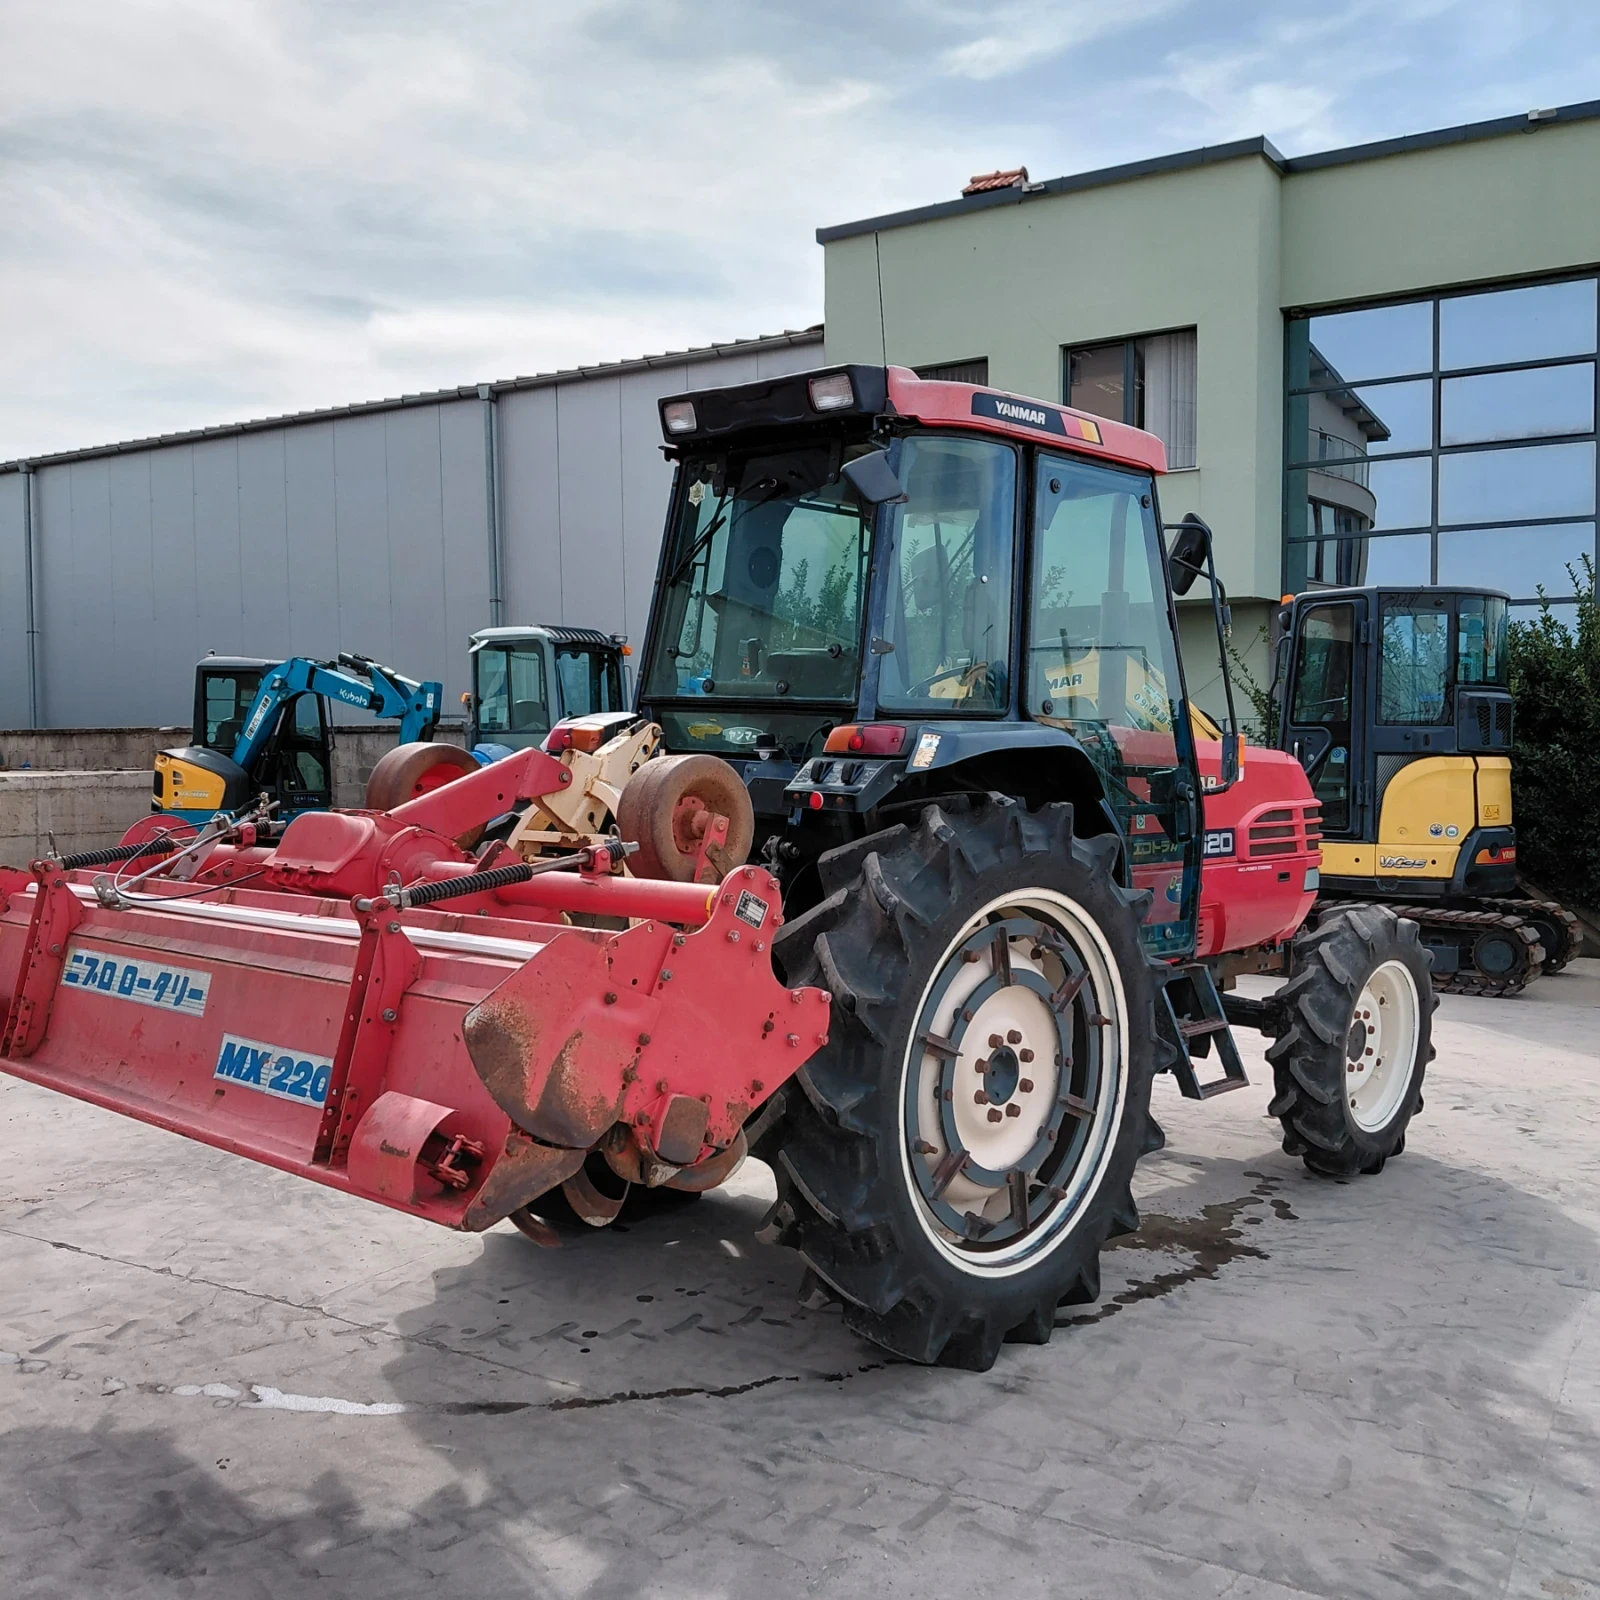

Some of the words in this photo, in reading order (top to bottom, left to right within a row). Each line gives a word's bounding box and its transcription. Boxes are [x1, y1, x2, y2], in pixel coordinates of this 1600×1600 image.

[995, 401, 1046, 425] YANMAR
[340, 688, 367, 706] Kubota
[1204, 832, 1233, 855] 20
[216, 1042, 273, 1085] MX
[268, 1056, 333, 1103] 220
